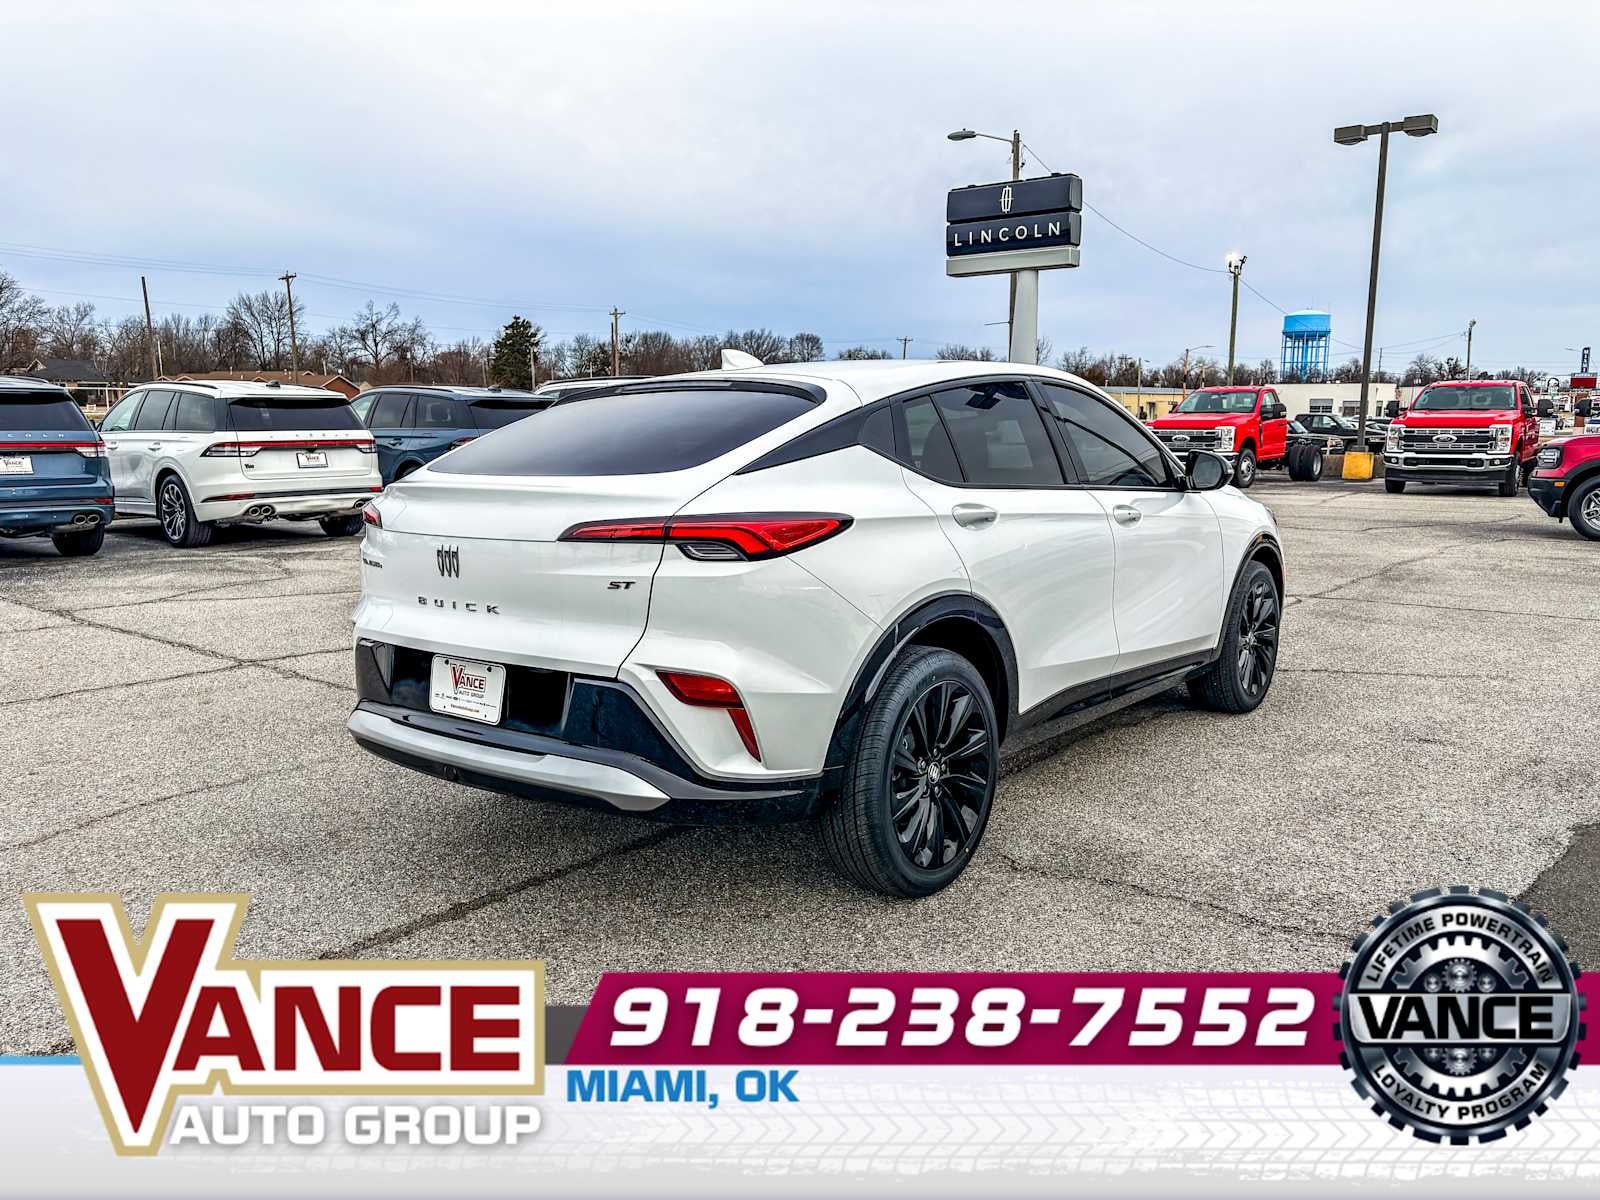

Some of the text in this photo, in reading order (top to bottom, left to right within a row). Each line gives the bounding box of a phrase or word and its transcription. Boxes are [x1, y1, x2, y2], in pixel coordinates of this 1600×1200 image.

[954, 222, 1060, 246] LINCOLN
[607, 581, 636, 589] ST
[418, 596, 500, 615] BUICK
[451, 665, 485, 690] VANCE
